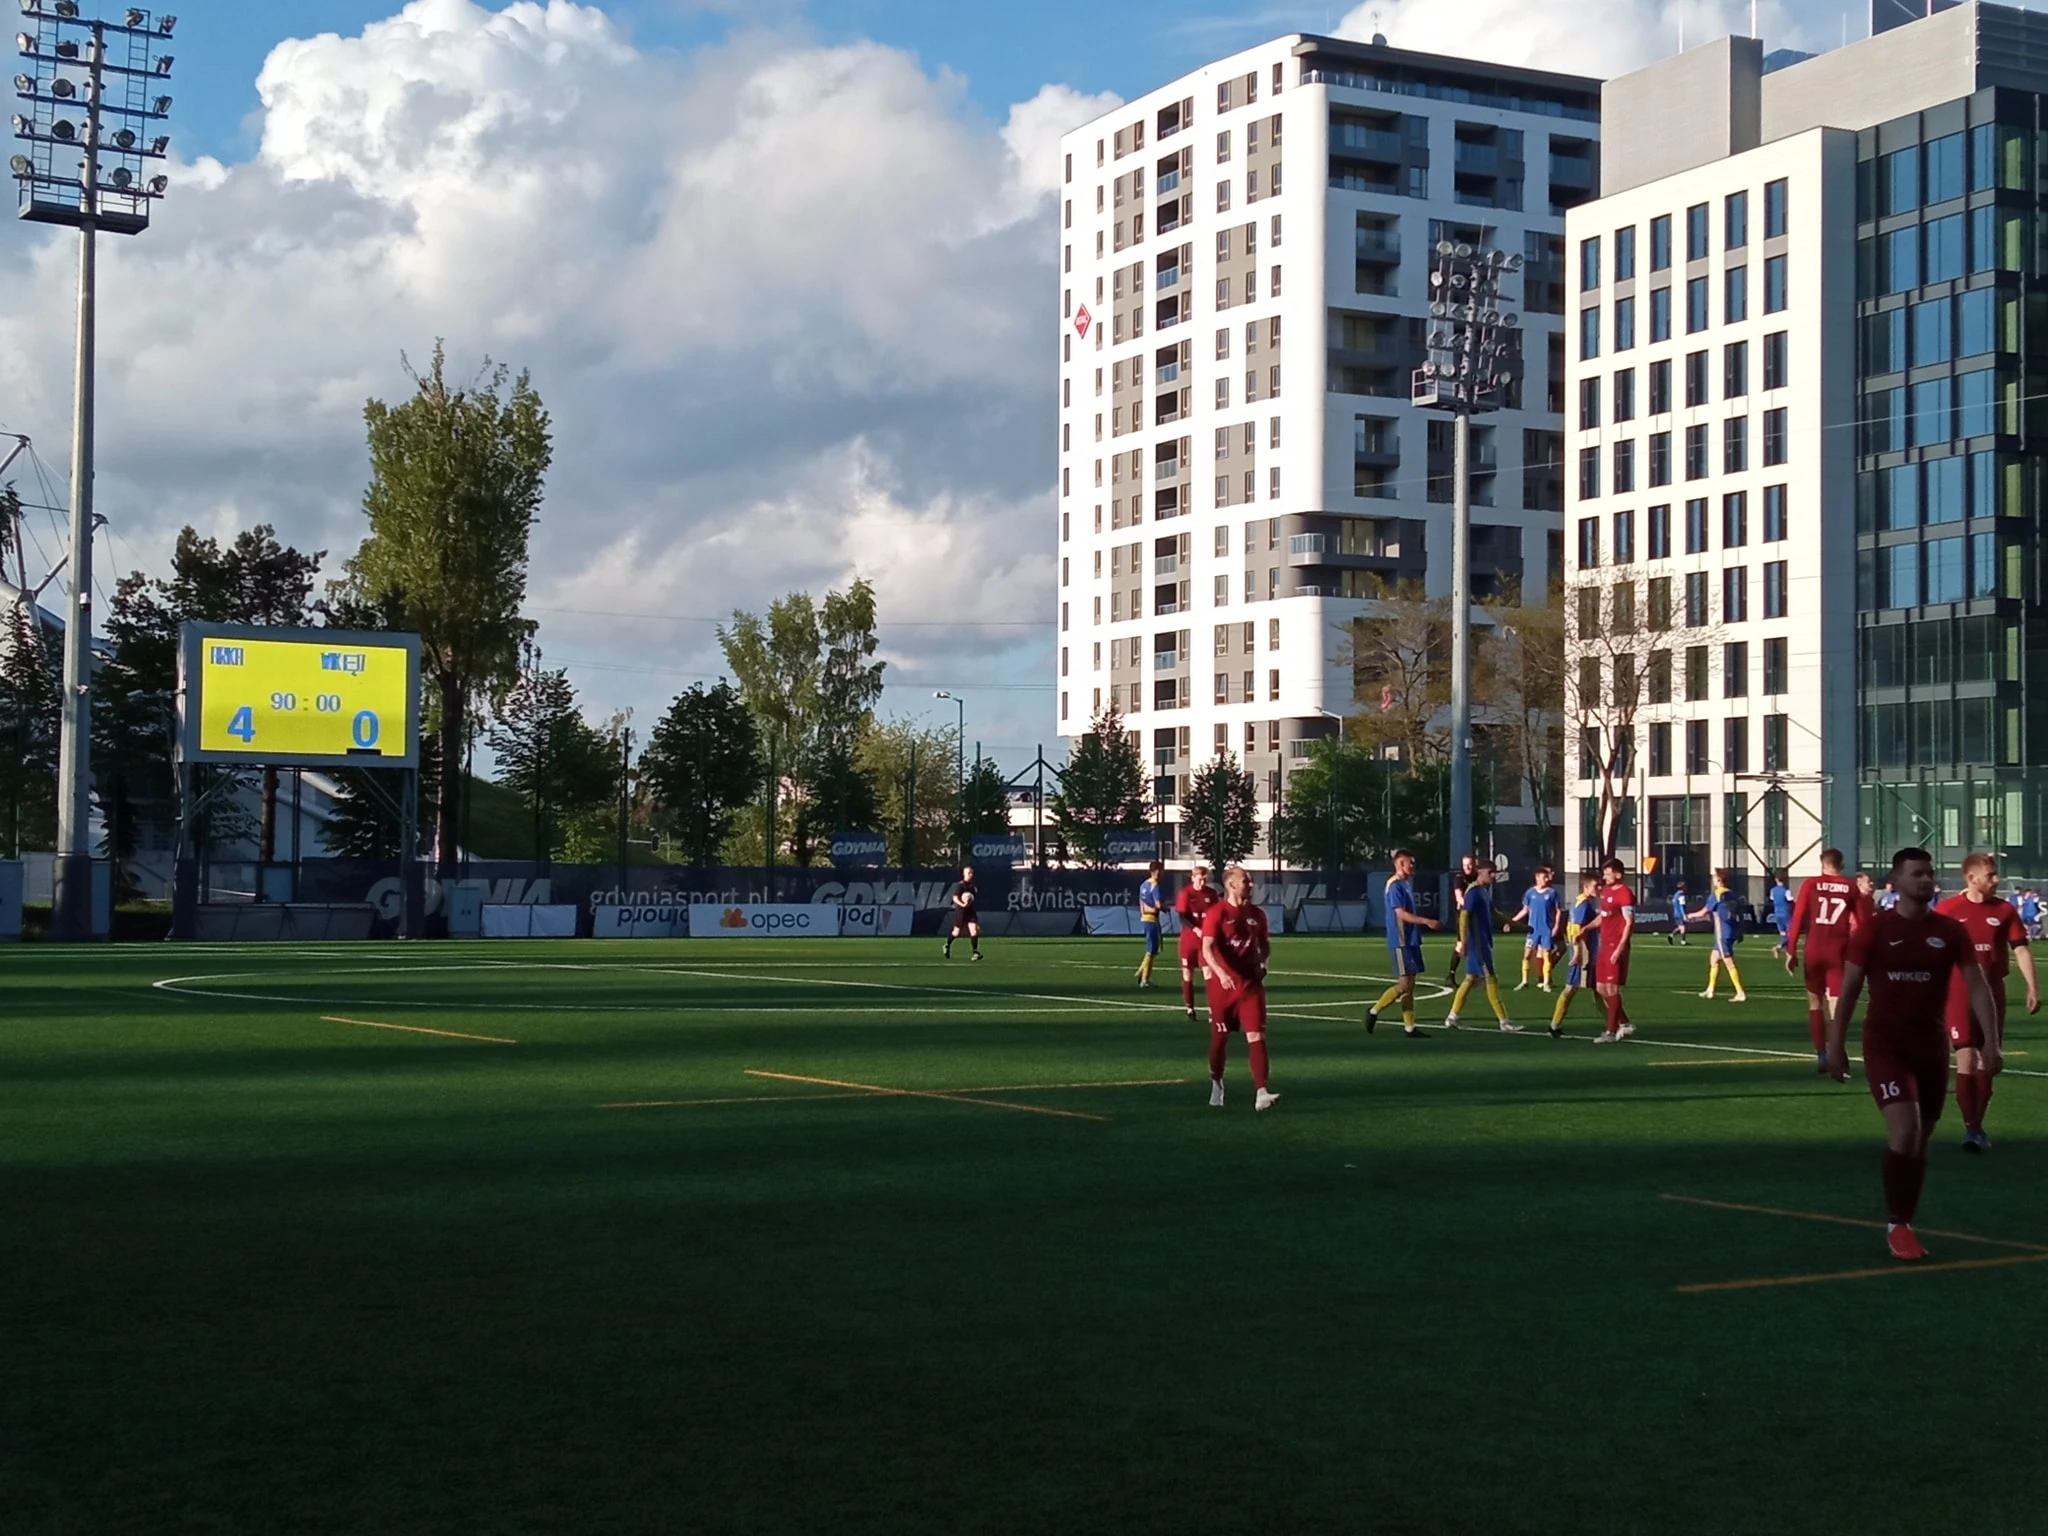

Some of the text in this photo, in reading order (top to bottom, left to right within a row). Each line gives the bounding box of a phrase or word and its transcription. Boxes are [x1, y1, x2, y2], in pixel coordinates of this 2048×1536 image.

[227, 705, 256, 743] 4
[352, 710, 379, 748] 0
[831, 841, 886, 856] GDYNIA
[972, 842, 1023, 858] GDYNIA
[1107, 840, 1156, 855] GDYNIA
[1815, 896, 1847, 925] 17
[751, 912, 810, 932] opec
[1879, 1080, 1900, 1100] 16
